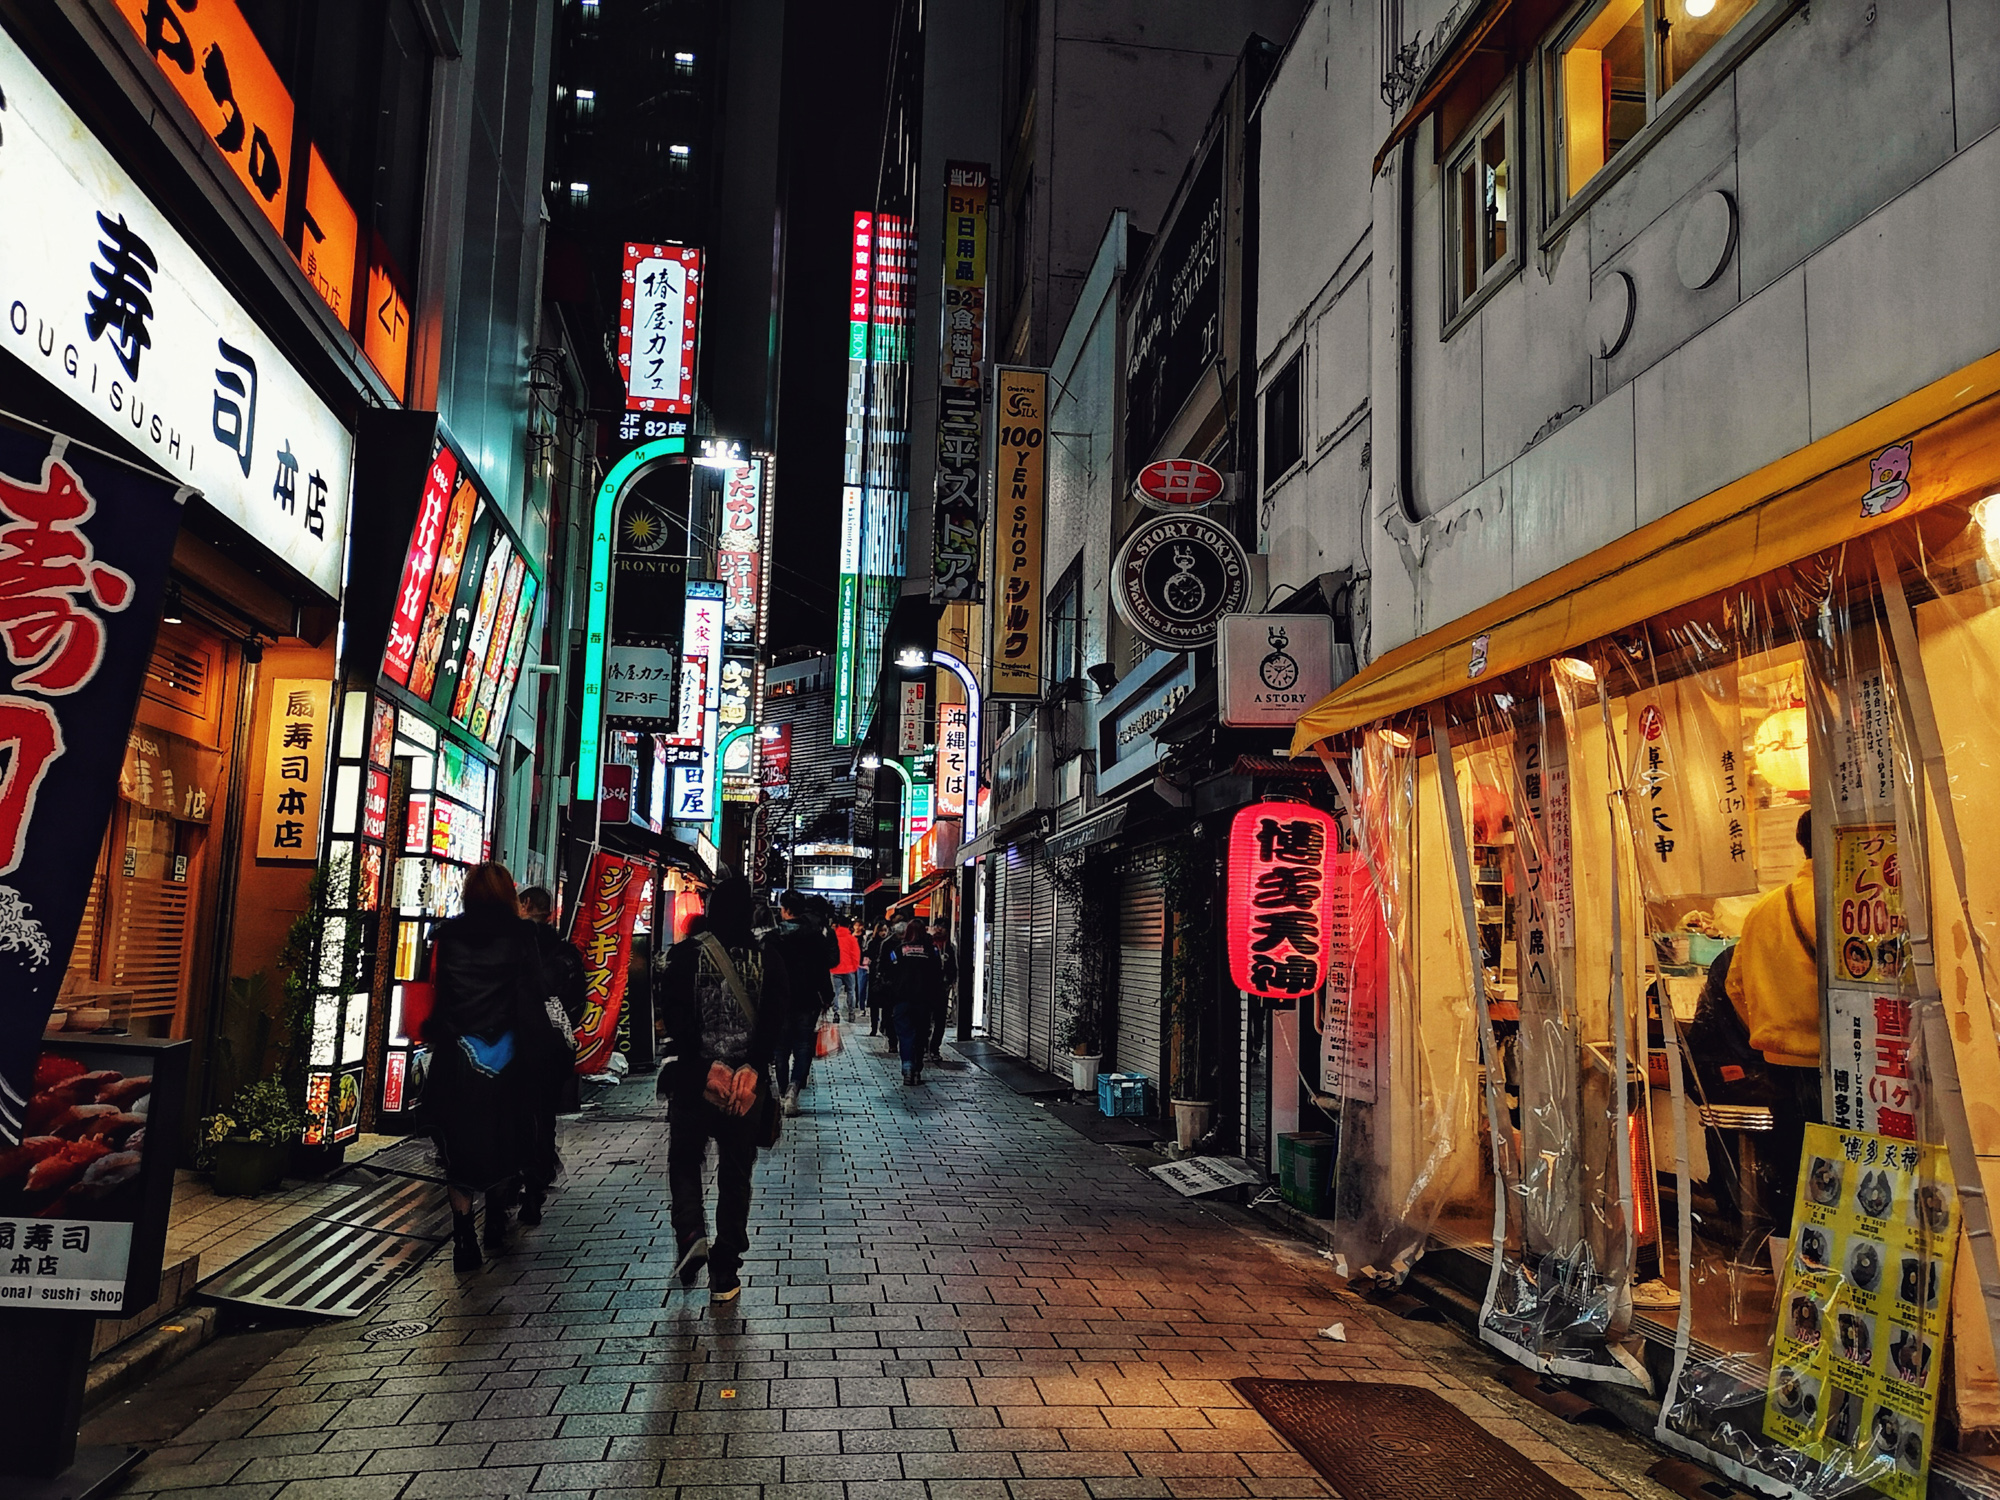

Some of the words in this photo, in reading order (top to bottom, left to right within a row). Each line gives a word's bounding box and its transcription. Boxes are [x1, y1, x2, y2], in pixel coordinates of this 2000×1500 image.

[956, 217, 975, 280] 日用品
[1171, 228, 1219, 338] KOMATSU
[643, 268, 678, 390] 椿屋カフェ
[951, 308, 975, 380] 食料品
[10, 300, 195, 471] OUGISUSHI
[619, 427, 640, 440] 3F
[1001, 426, 1043, 448] 100
[938, 399, 977, 583] 三平ストア
[1011, 451, 1031, 500] YEN
[614, 560, 680, 574] RONTO
[1010, 506, 1028, 572] SHOP
[1128, 559, 1144, 573] A
[1136, 523, 1191, 556] STORY
[1194, 525, 1240, 577] TOKYO
[1004, 577, 1031, 658] シルク
[1128, 580, 1162, 628] Watches
[1161, 620, 1217, 637] Jewelry
[388, 620, 415, 660] ラーメン
[1254, 694, 1263, 703] A
[1266, 694, 1307, 703] STORY
[273, 690, 315, 849] 扇寿司本店
[945, 708, 967, 794] 沖縄そば
[1250, 818, 1325, 993] 博多天神
[1844, 1136, 1919, 1176] 博多天神
[0, 1221, 90, 1254] 扇寿司
[9, 1254, 59, 1276] 本店
[0, 1285, 33, 1299] onal
[41, 1287, 81, 1301] sushi
[89, 1288, 123, 1304] shop
